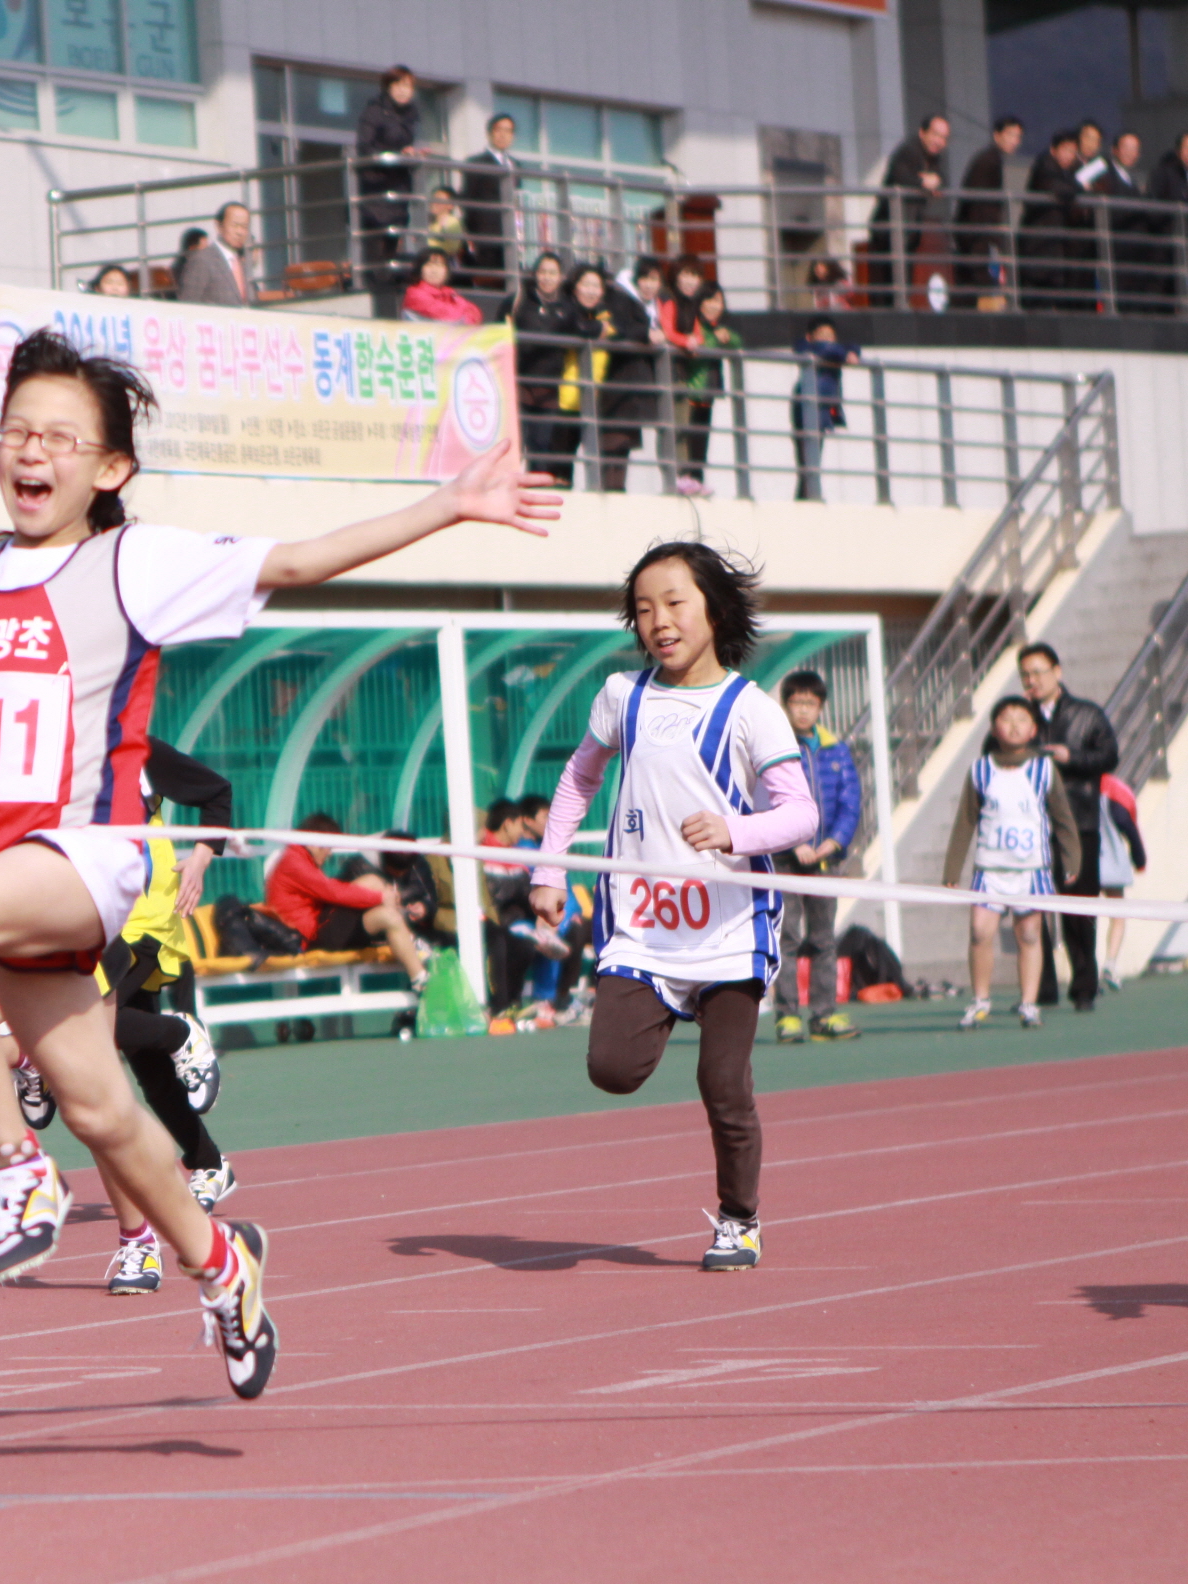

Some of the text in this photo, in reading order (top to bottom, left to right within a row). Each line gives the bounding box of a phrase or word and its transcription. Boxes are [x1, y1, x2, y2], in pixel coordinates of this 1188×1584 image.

[144, 316, 186, 388] 육상
[196, 319, 304, 396] 꿈나무선수
[463, 372, 497, 431] 승
[996, 826, 1034, 852] 163
[629, 878, 711, 931] 260
